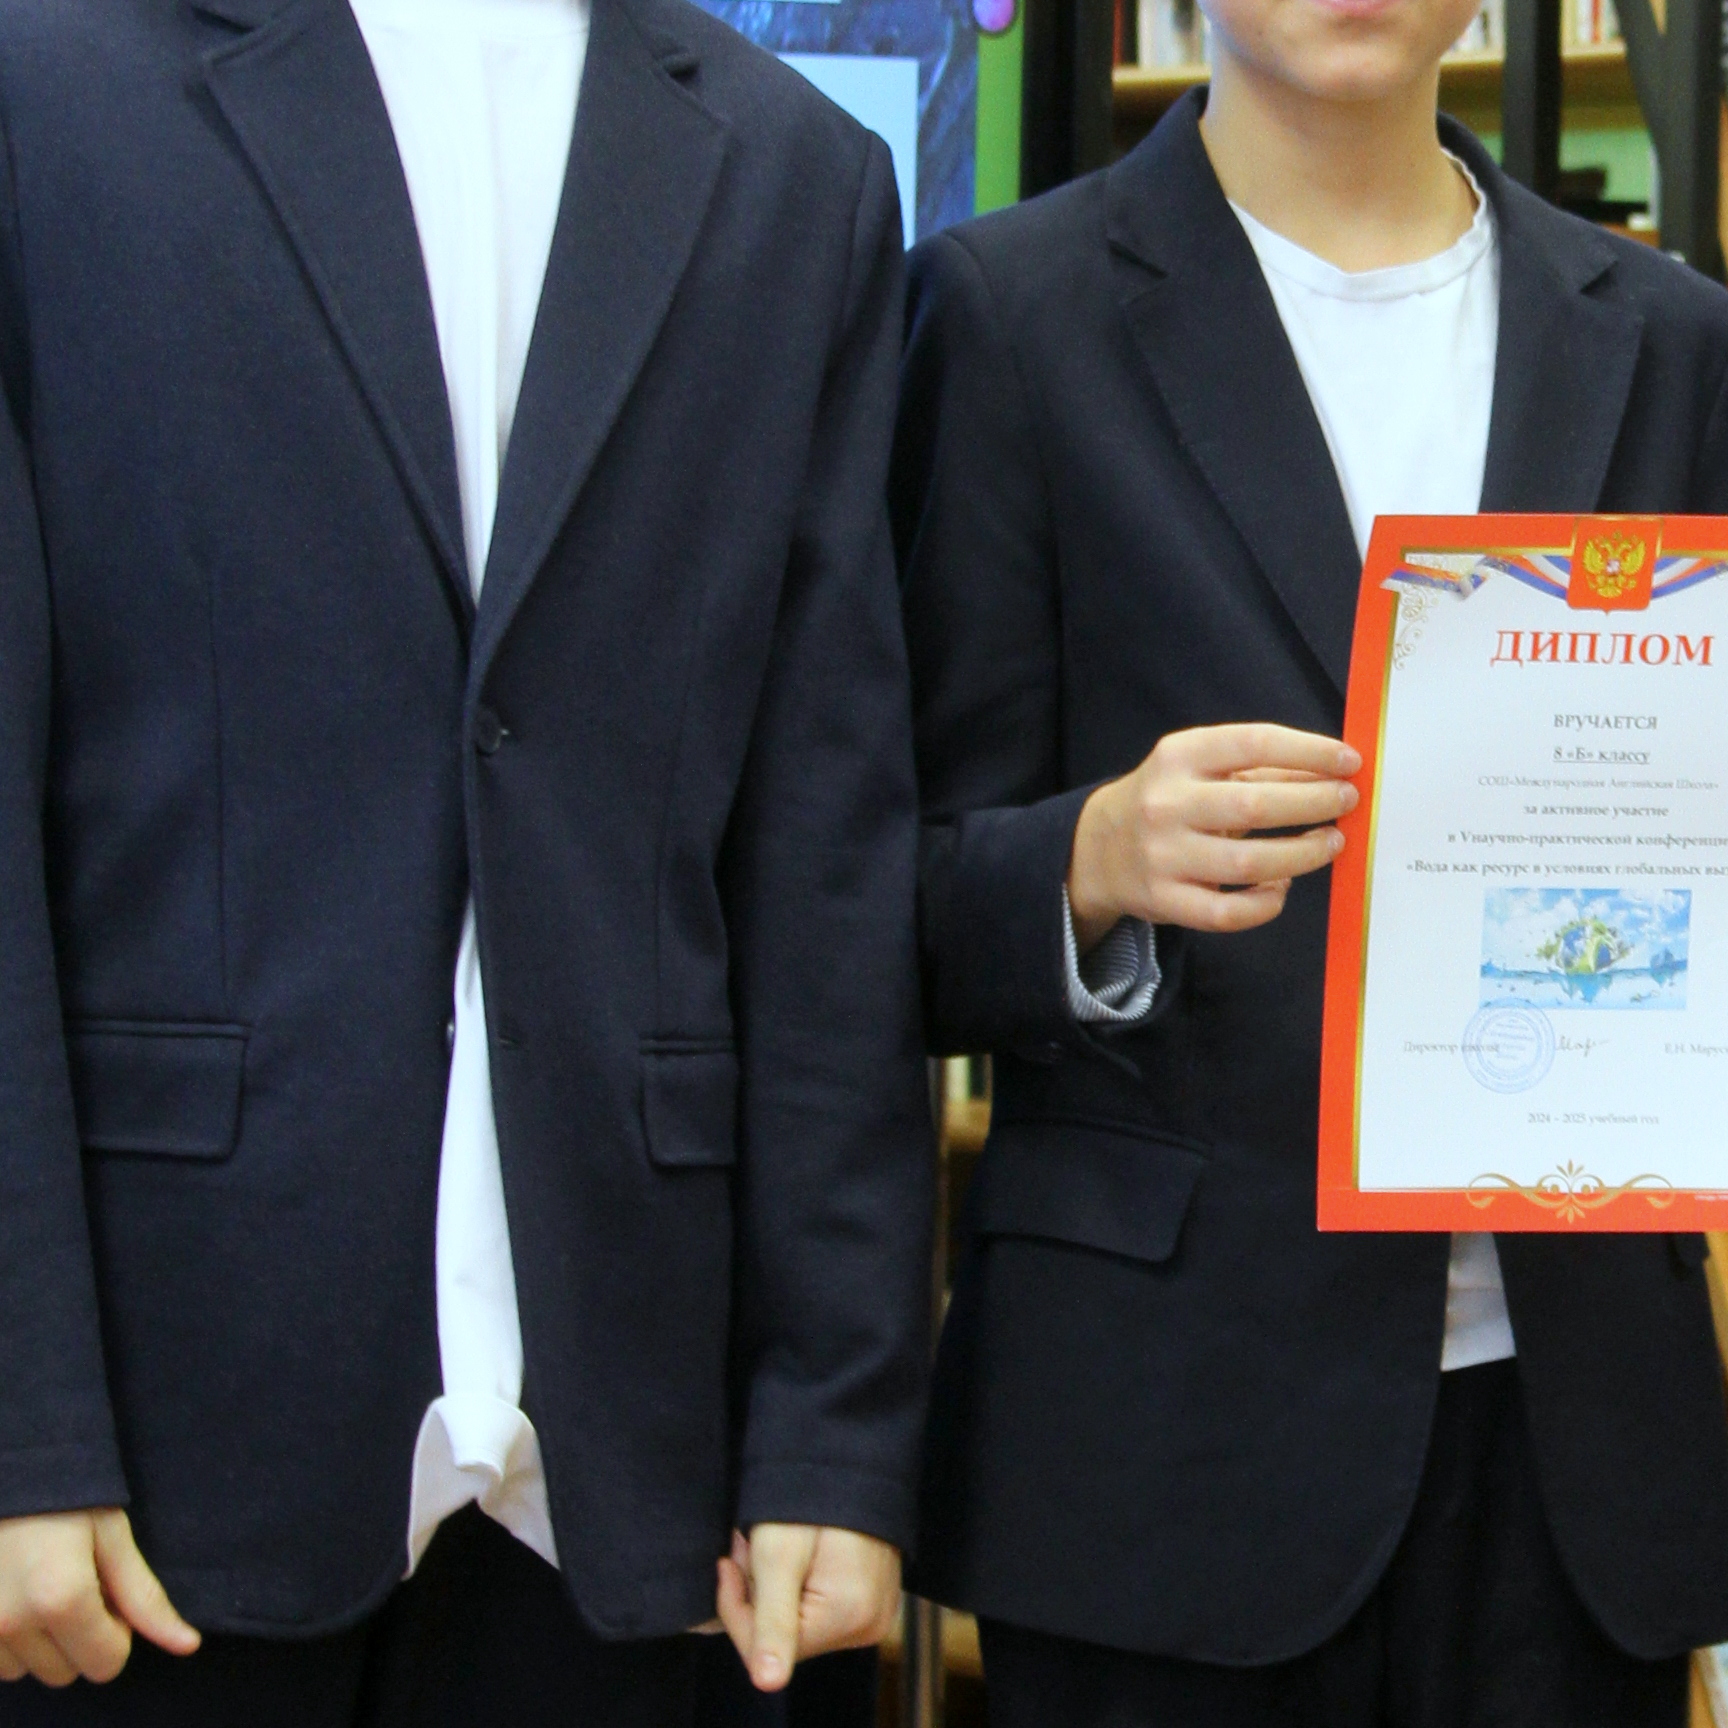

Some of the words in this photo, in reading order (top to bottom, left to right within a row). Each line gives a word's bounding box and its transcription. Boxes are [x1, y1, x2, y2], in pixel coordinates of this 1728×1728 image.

[1489, 629, 1716, 668] ДИПЛОМ
[1553, 713, 1658, 732] ВРУЧАЕТСЯ
[1598, 749, 1651, 764] классу
[1523, 805, 1537, 816] за
[1541, 805, 1609, 816] активное
[1612, 806, 1670, 820] участие
[1452, 862, 1477, 874] как
[1481, 862, 1529, 878] ресурс
[1544, 863, 1612, 878] условиях
[1615, 862, 1702, 877] глобальных
[1527, 1113, 1551, 1124] 2024
[1562, 1113, 1586, 1124] 2025
[1589, 1114, 1638, 1127] учебный
[1640, 1115, 1660, 1125] год
